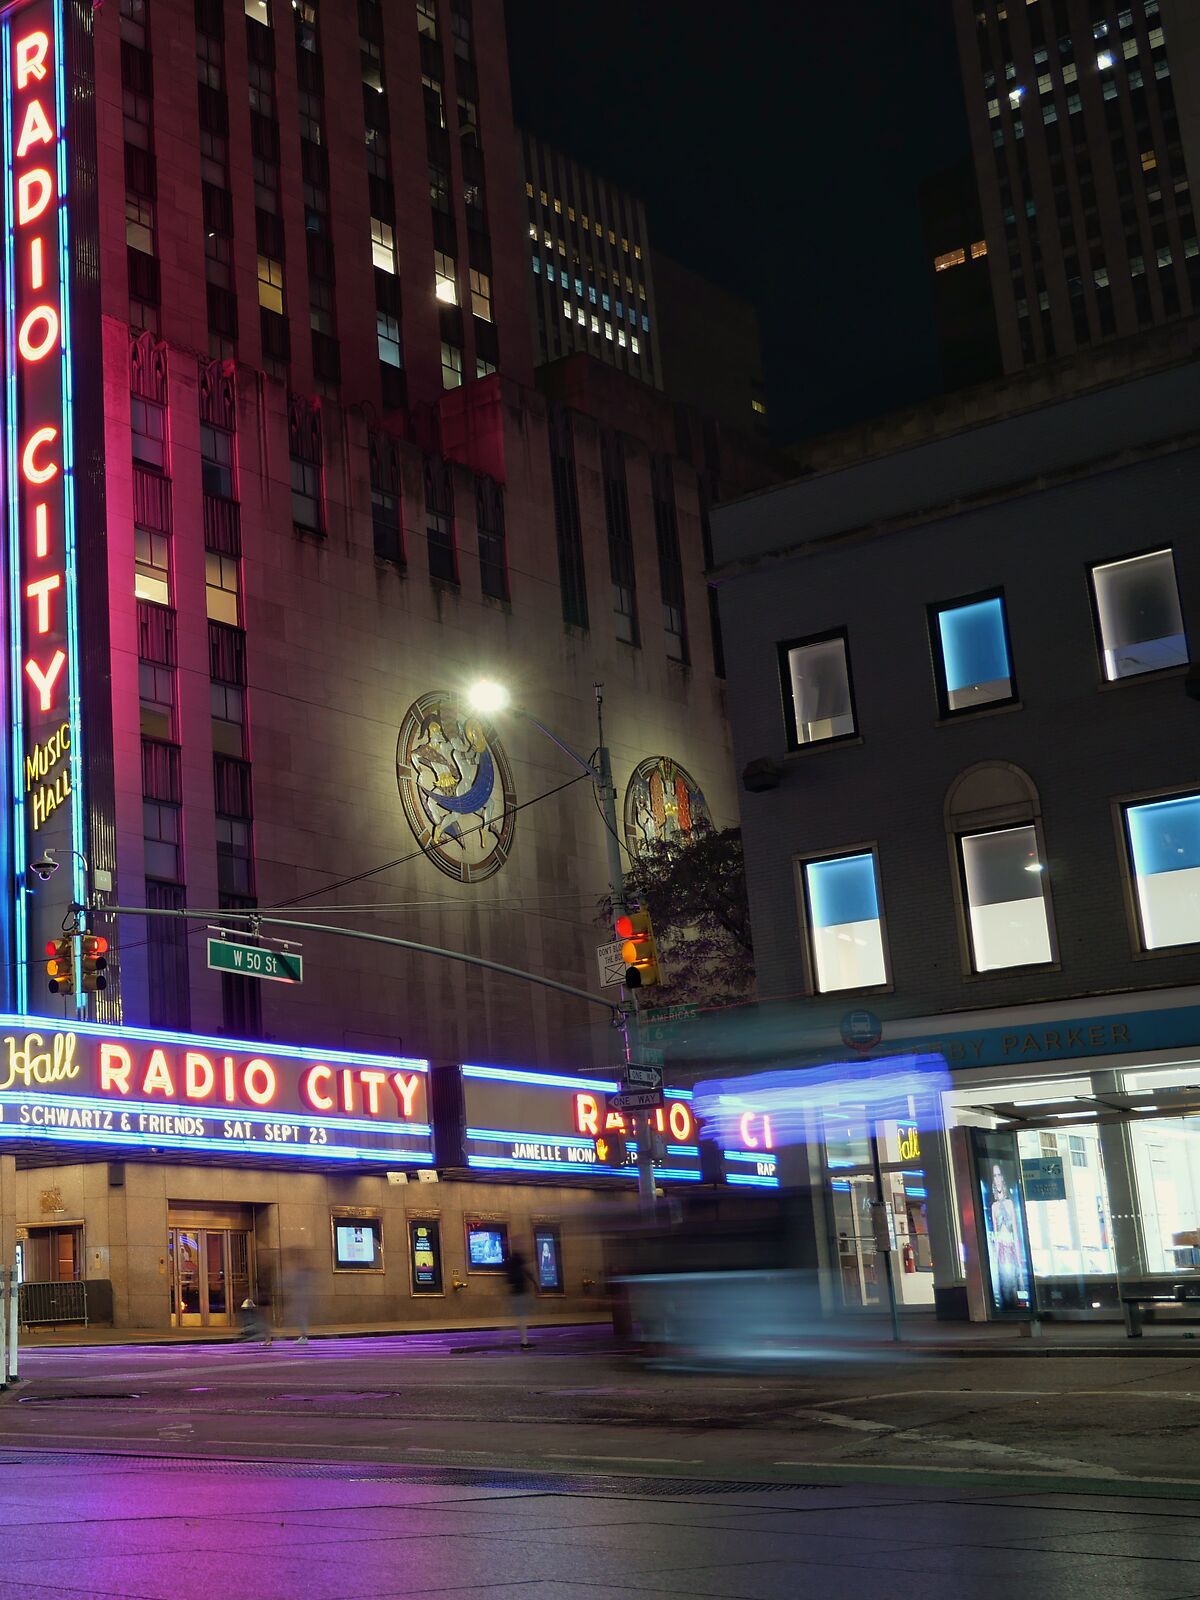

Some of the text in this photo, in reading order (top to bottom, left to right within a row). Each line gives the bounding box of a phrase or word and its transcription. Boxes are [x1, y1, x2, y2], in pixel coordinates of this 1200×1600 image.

[16, 30, 66, 712] RADIO CITY
[26, 722, 71, 792] MUSIC
[33, 769, 72, 830] HALL
[233, 949, 278, 973] W 50 St
[651, 1009, 697, 1023] AMERICAS
[1002, 1023, 1133, 1055] PARKER
[100, 1043, 420, 1118] RADIO CITY
[632, 1070, 658, 1082] ONE WAY
[614, 1094, 657, 1106] ONE WAY
[19, 1105, 113, 1131] SCHWARTZ
[120, 1112, 131, 1132] &
[138, 1114, 205, 1137] FRIENDS
[223, 1120, 257, 1141] SAT.
[264, 1124, 301, 1144] SEPT
[309, 1126, 328, 1146] 23
[576, 1093, 691, 1141] RAIO
[511, 1143, 562, 1162] JANELLE
[756, 1162, 776, 1176] RAP
